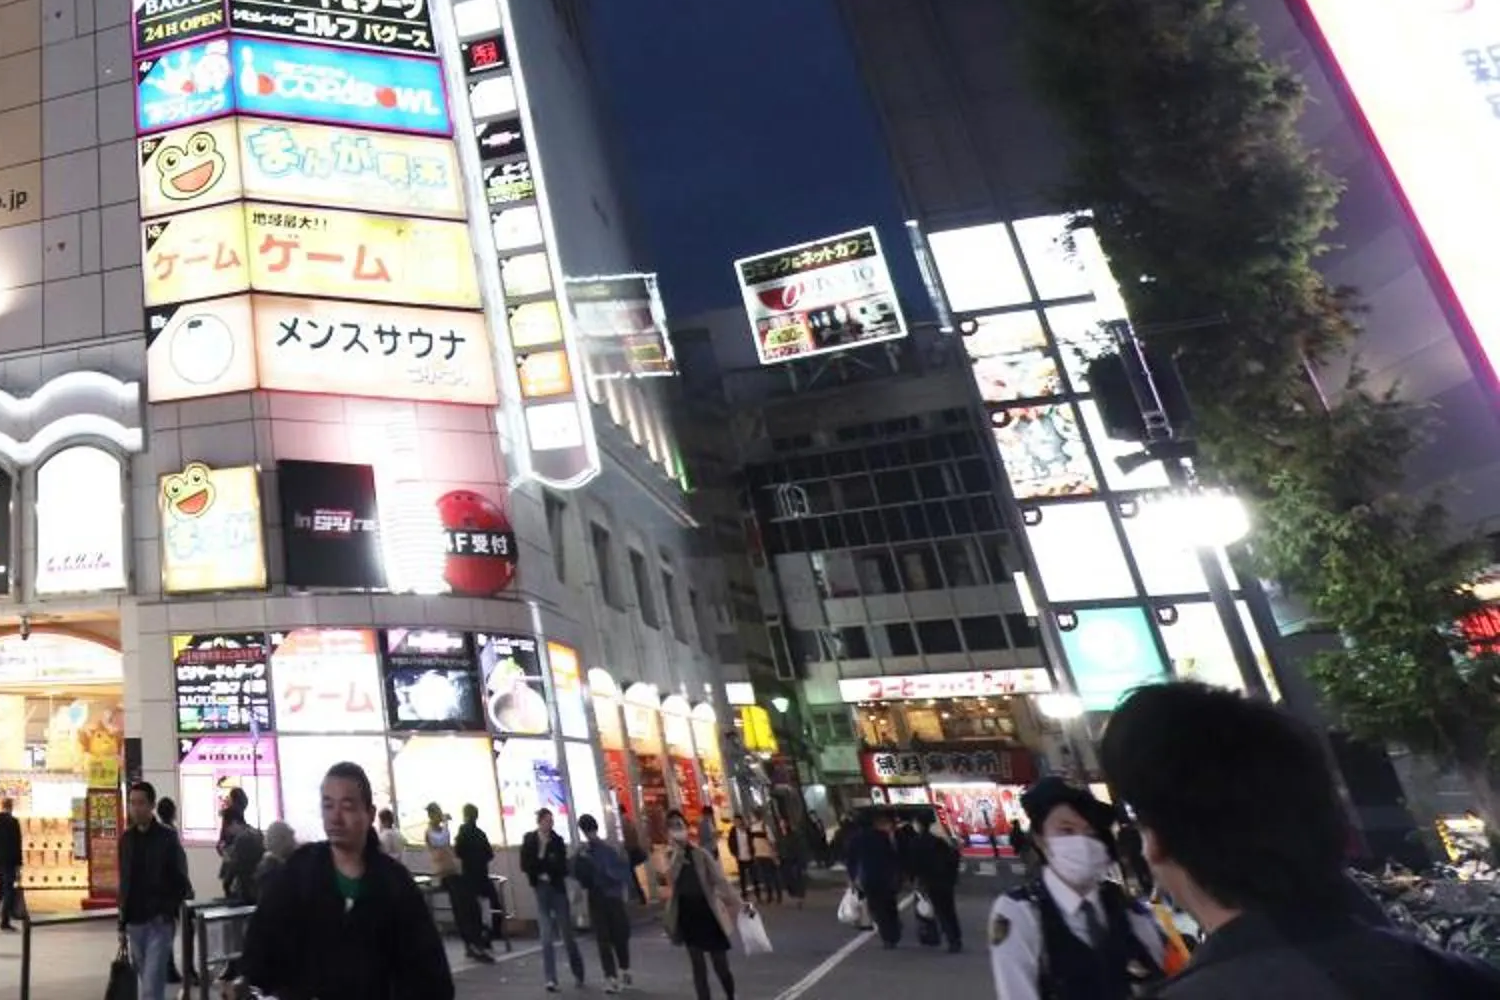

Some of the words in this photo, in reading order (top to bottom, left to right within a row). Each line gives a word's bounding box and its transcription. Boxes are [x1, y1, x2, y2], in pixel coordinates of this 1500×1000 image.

[180, 9, 223, 31] OPEN
[259, 233, 392, 283] ゲーム
